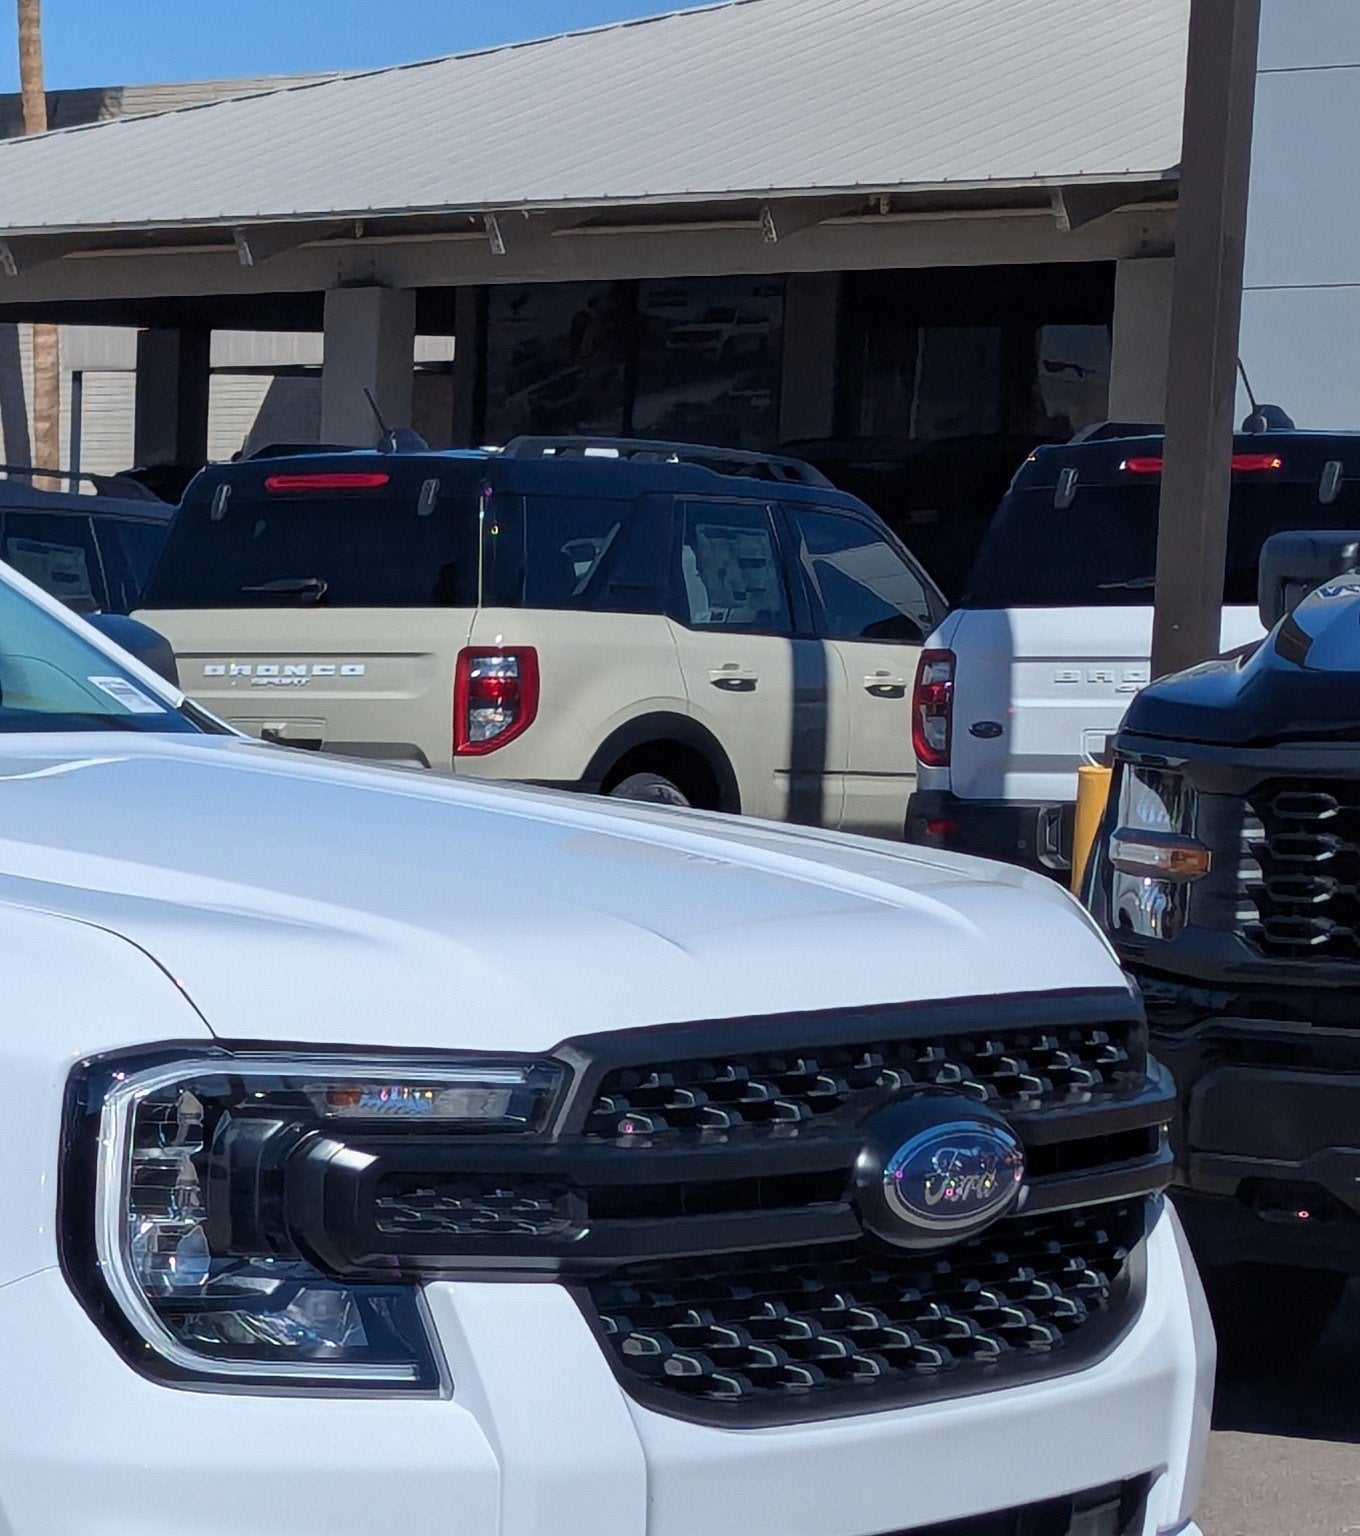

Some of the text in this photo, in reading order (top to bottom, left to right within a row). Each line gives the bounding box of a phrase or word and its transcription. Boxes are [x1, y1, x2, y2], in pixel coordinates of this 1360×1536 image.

[204, 664, 366, 676] BRONCO
[1053, 669, 1149, 683] BRO
[924, 1147, 999, 1206] Ford
